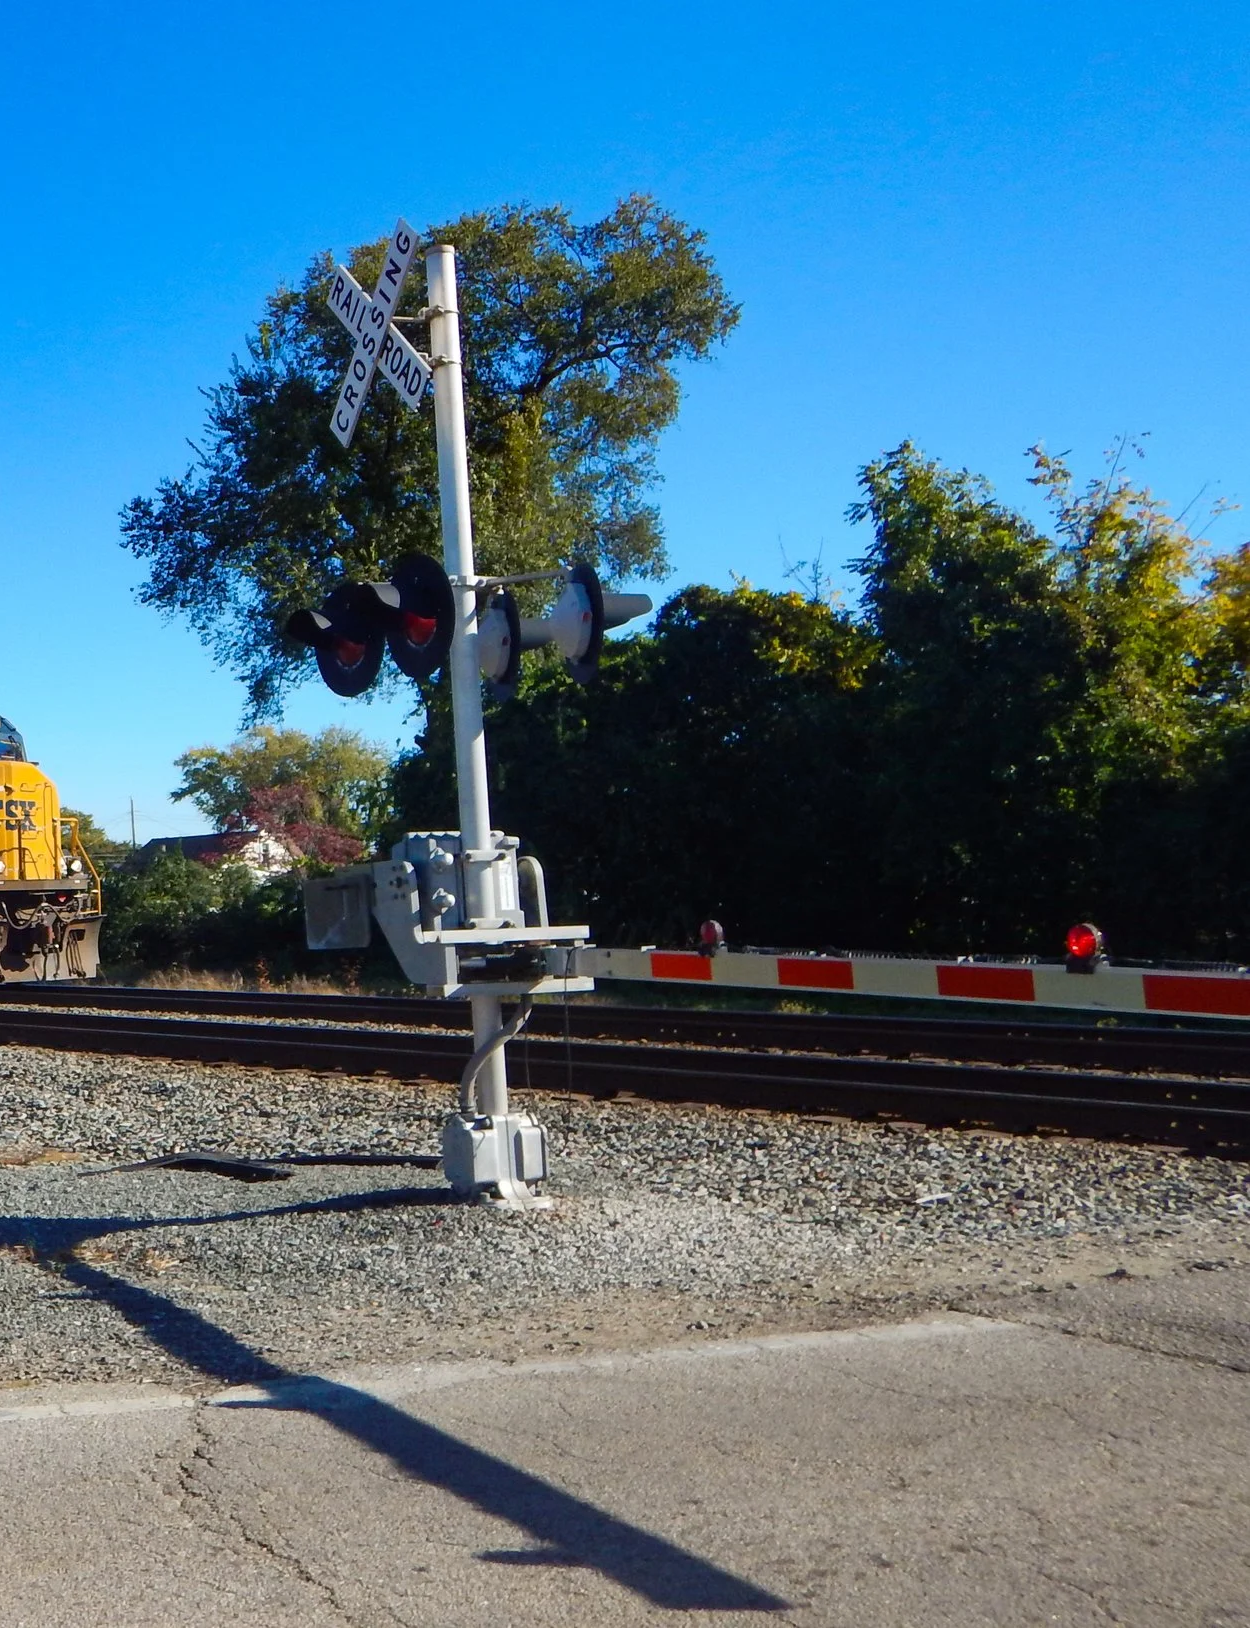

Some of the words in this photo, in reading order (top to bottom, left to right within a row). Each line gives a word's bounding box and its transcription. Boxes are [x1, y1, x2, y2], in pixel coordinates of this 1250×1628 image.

[331, 275, 368, 334] RAIL
[379, 335, 423, 397] ROAD
[336, 231, 411, 433] CROSSING
